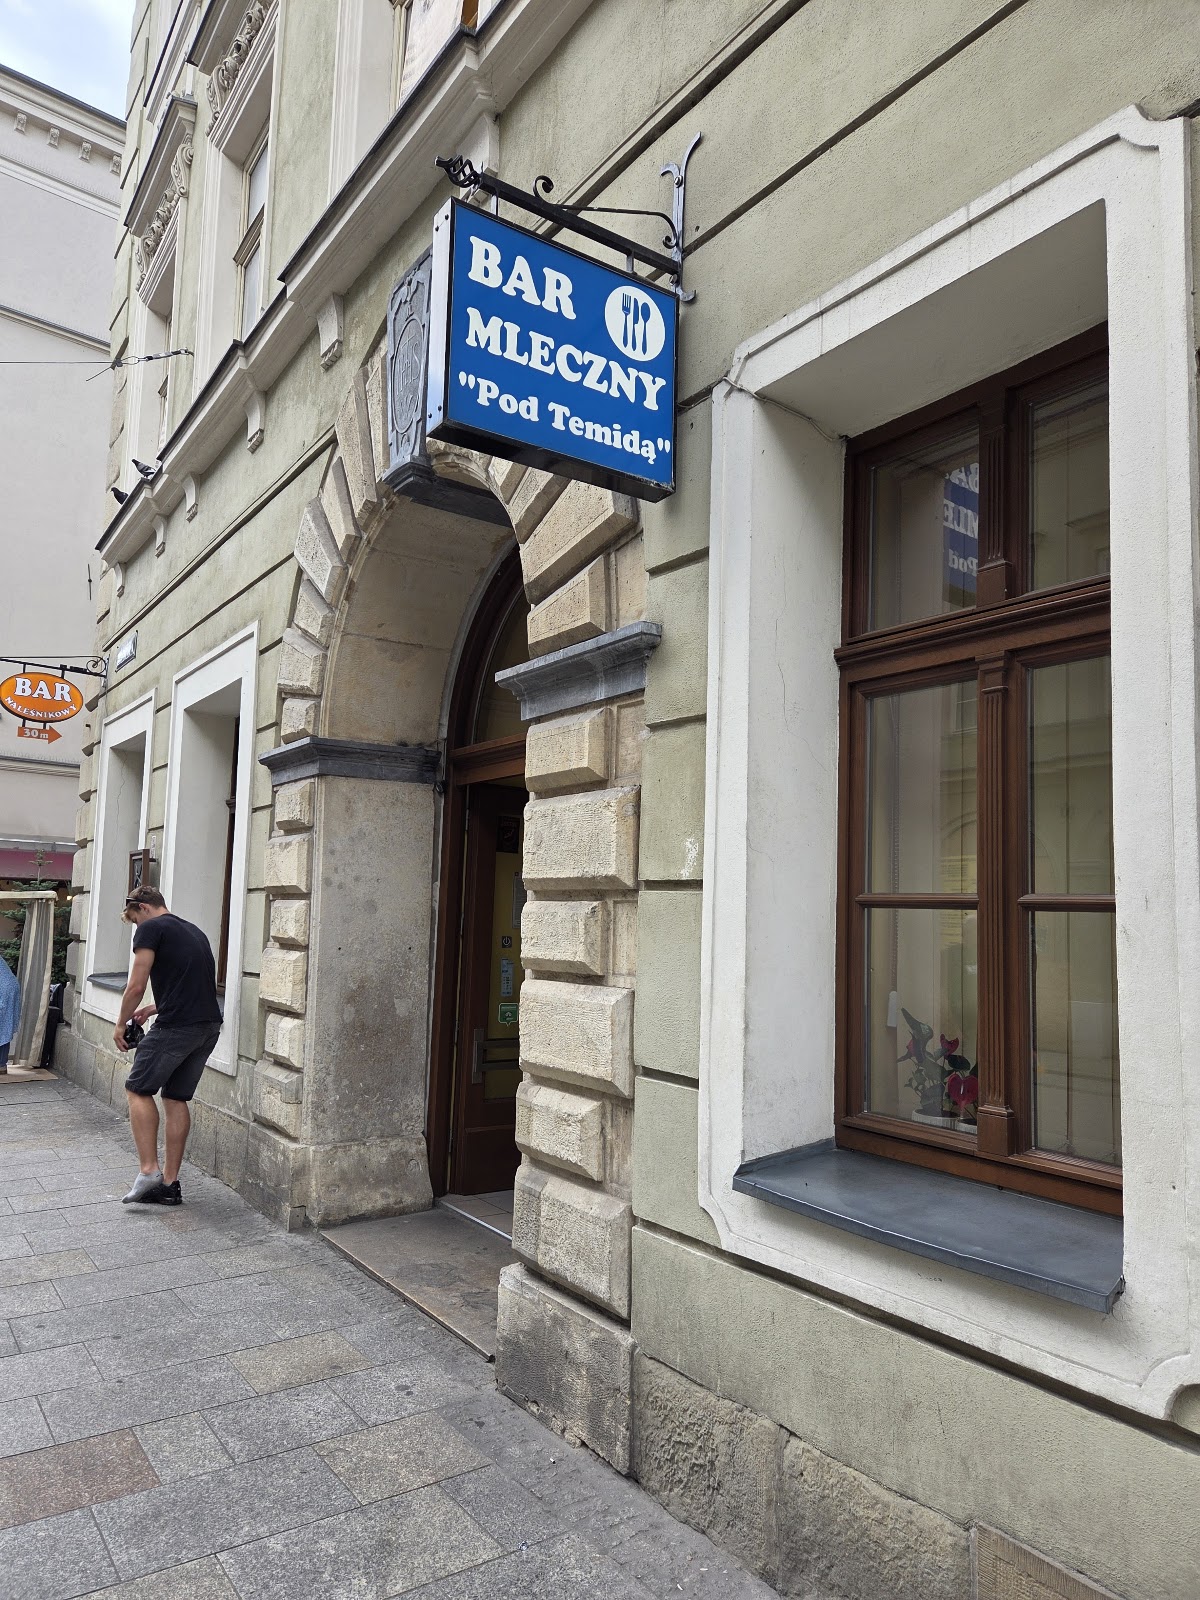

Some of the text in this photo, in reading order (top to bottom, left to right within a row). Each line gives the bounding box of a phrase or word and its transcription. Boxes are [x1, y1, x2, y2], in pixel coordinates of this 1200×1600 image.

[468, 235, 577, 320] BAR
[465, 307, 667, 411] MLECZNY
[458, 371, 671, 465] "Pod Temidą"
[5, 696, 77, 719] NALEŚNIKOWY
[14, 677, 72, 703] BAR
[23, 728, 39, 738] 30
